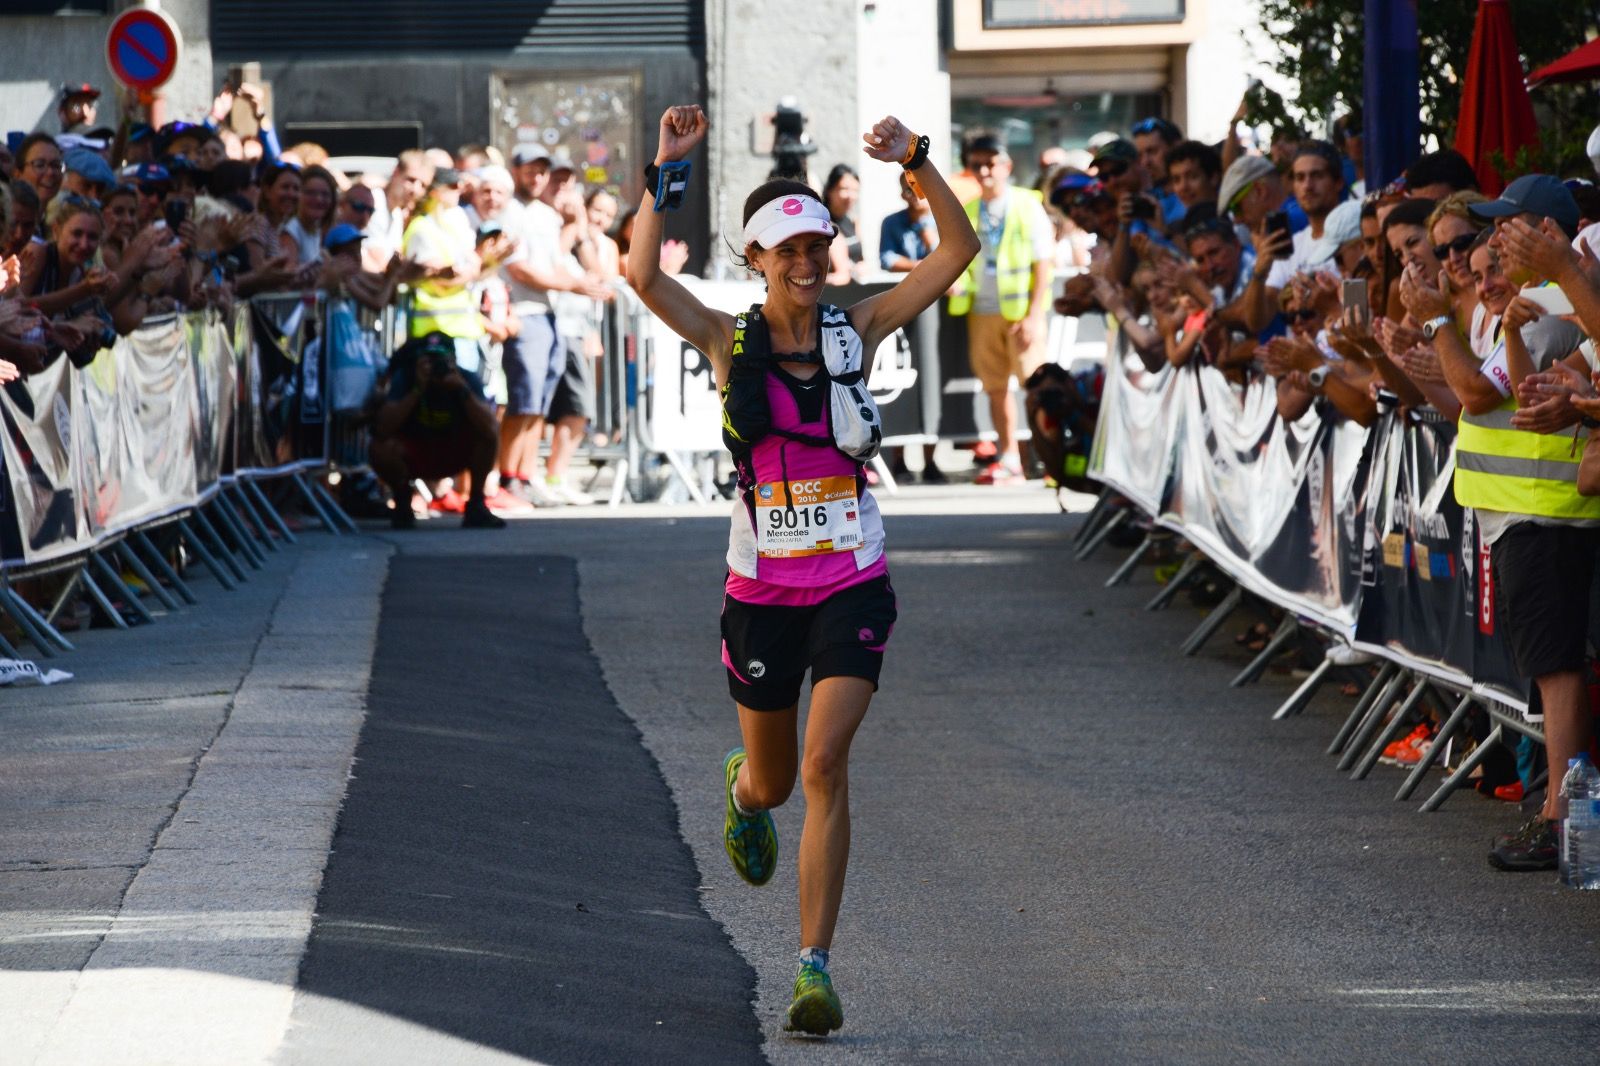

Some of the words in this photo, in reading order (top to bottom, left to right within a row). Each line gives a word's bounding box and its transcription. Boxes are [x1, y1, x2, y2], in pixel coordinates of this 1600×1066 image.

[792, 481, 822, 494] OCC
[797, 495, 817, 503] 2016
[769, 505, 828, 530] 9016
[767, 529, 808, 538] Mercedes
